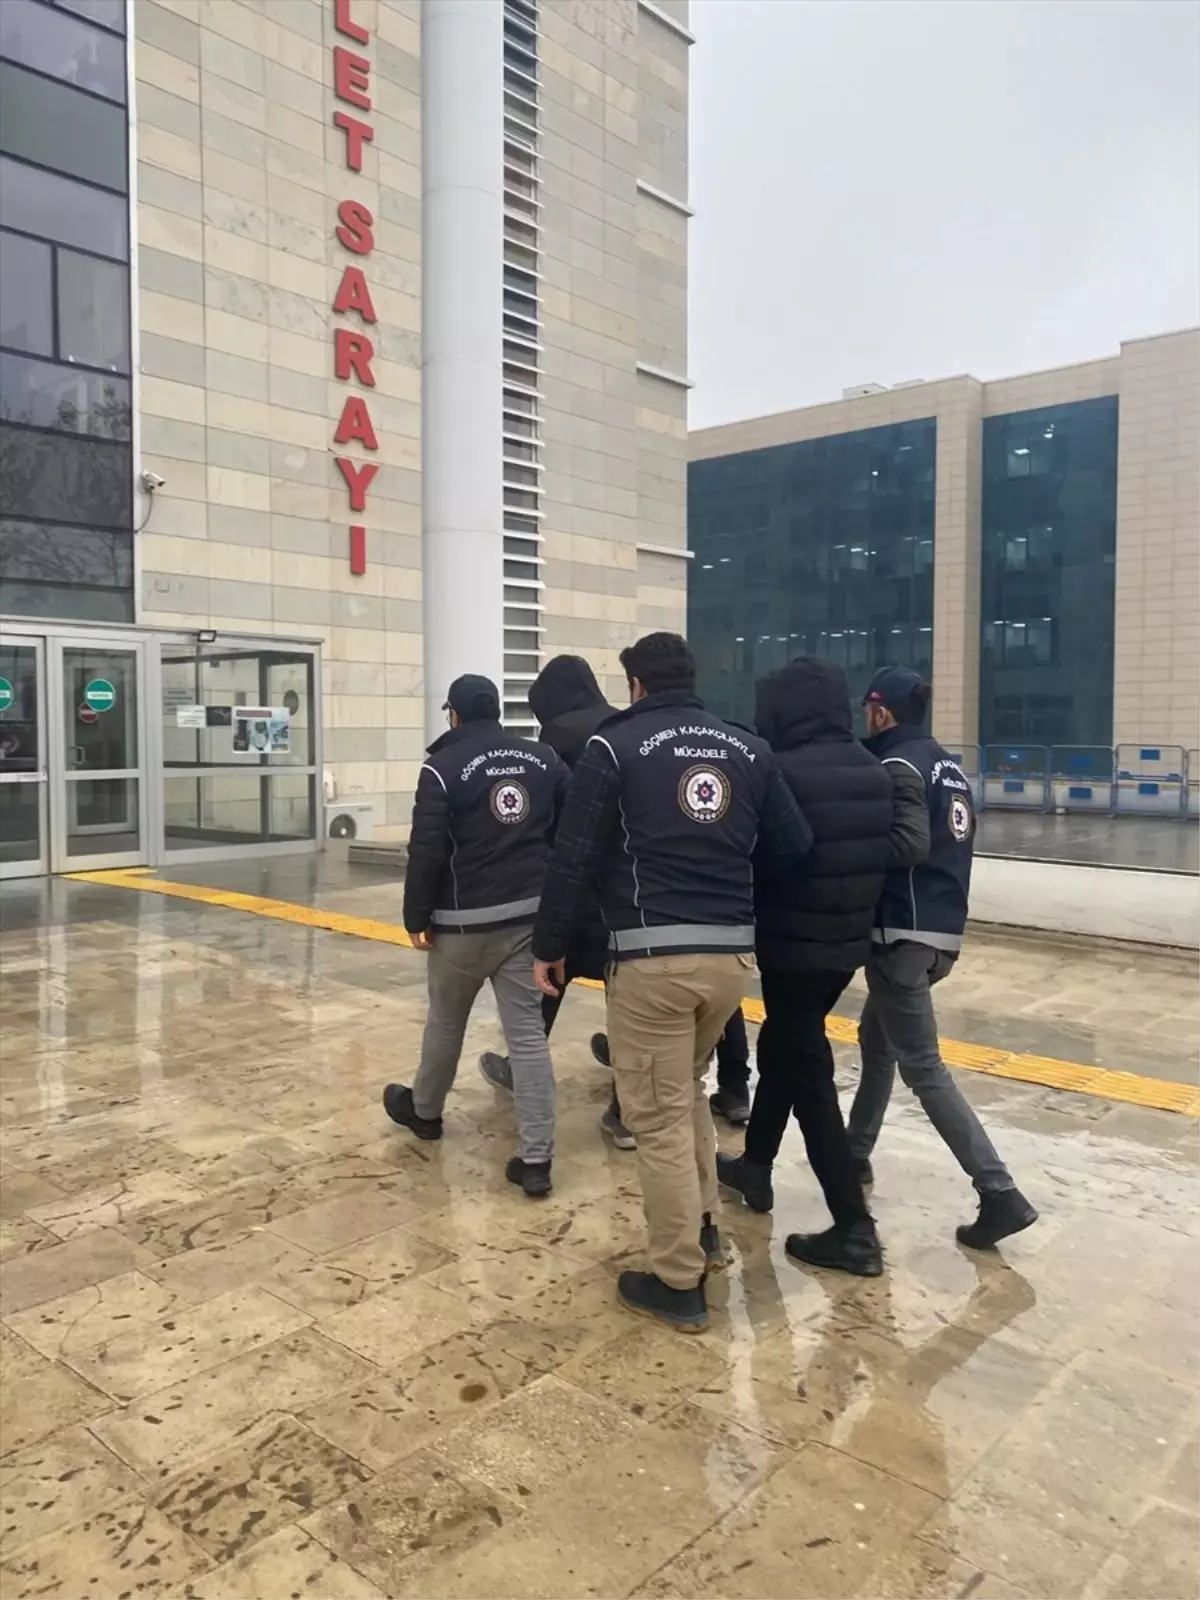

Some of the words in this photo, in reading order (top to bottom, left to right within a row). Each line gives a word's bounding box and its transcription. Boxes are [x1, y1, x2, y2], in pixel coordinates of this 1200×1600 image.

[332, 199, 380, 576] SARAYI
[640, 728, 678, 756] GÖÇMEN
[674, 745, 728, 759] MÜCADELE
[461, 754, 488, 781] GÖÇMEN
[485, 766, 526, 776] MÜCADELE
